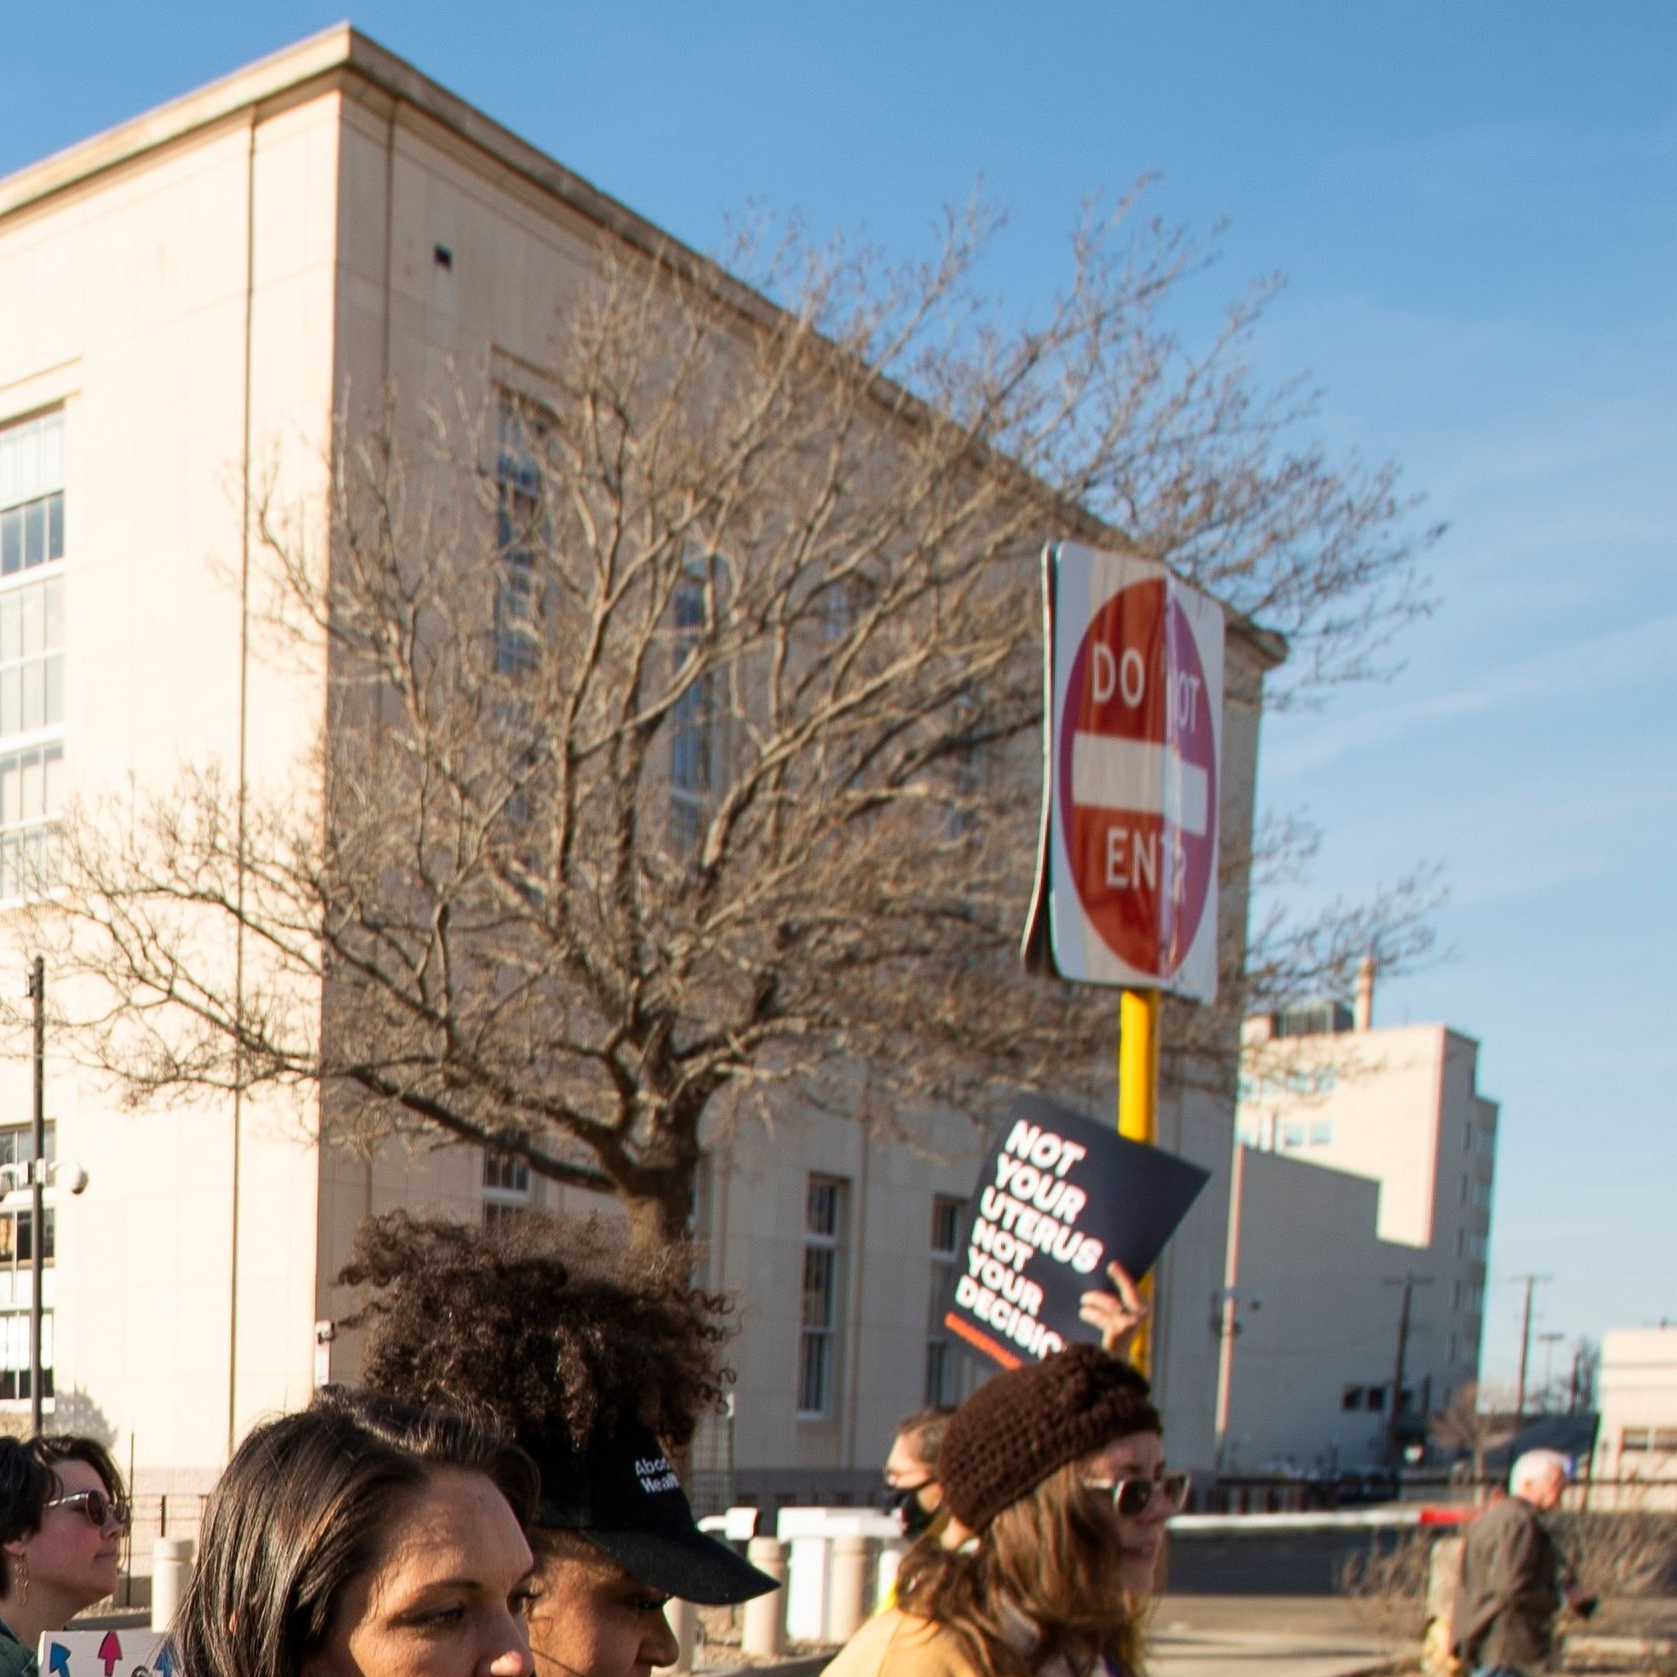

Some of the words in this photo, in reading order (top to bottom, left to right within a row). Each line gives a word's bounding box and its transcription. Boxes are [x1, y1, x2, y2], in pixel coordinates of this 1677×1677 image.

[1092, 640, 1146, 710] DO
[1004, 1118, 1088, 1178] NOT
[995, 1151, 1088, 1226] YOUR
[971, 1217, 1035, 1273] NOT
[980, 1185, 1105, 1275] UTERUS
[954, 1273, 1064, 1360] DECISIO
[967, 1245, 1044, 1317] YOUR
